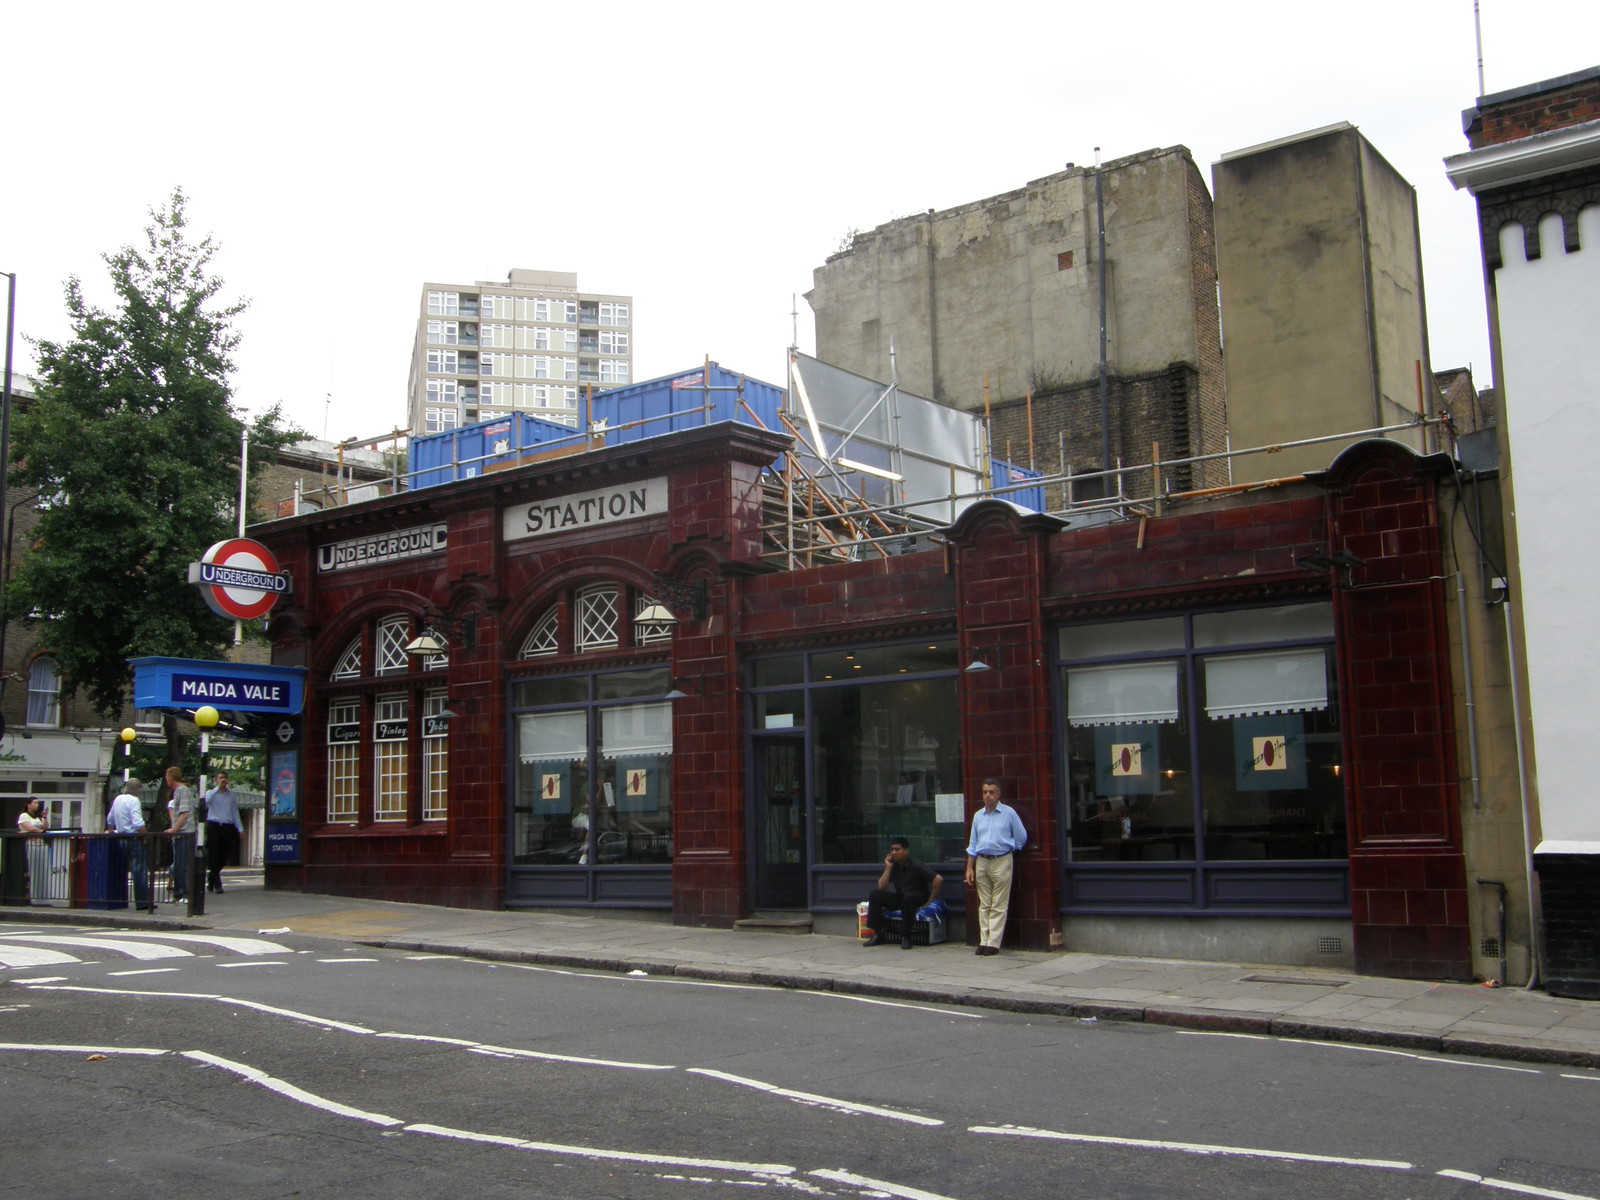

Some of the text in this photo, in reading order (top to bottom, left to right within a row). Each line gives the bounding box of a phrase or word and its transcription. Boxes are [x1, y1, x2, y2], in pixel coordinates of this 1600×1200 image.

[526, 488, 647, 533] STATION
[319, 524, 448, 571] UNDERGROUND
[202, 565, 287, 591] UNDERGROUND
[182, 680, 280, 701] MAIDA VALE
[268, 832, 298, 841] MAIDA VALE
[271, 844, 294, 852] STATION
